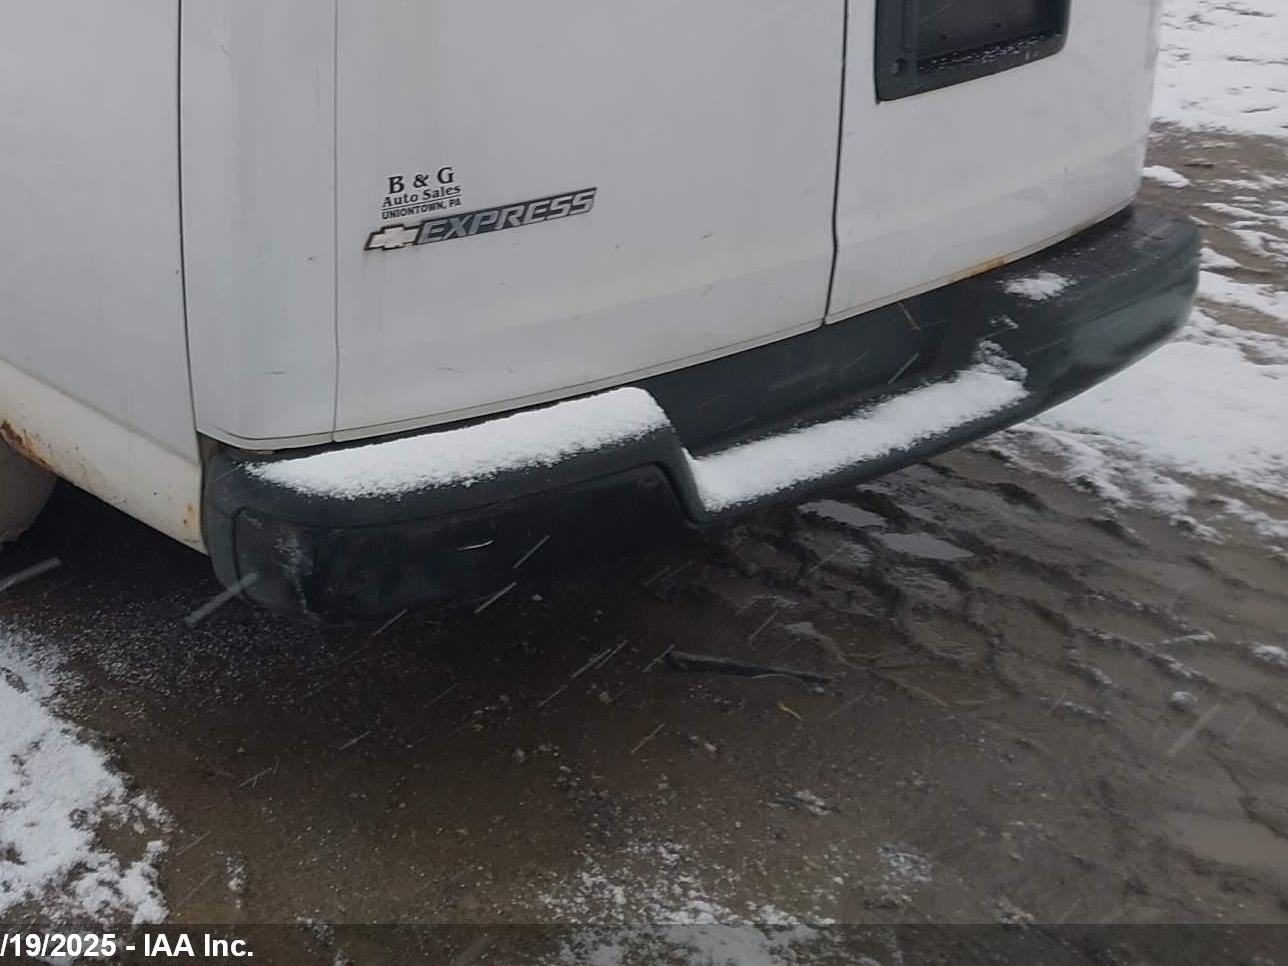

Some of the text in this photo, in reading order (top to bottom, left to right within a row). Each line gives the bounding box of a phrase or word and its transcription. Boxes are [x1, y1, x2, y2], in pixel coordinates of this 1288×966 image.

[387, 166, 455, 194] B & G
[382, 185, 461, 208] Auto Sales
[448, 197, 462, 208] PA
[415, 188, 597, 245] EXPRESS
